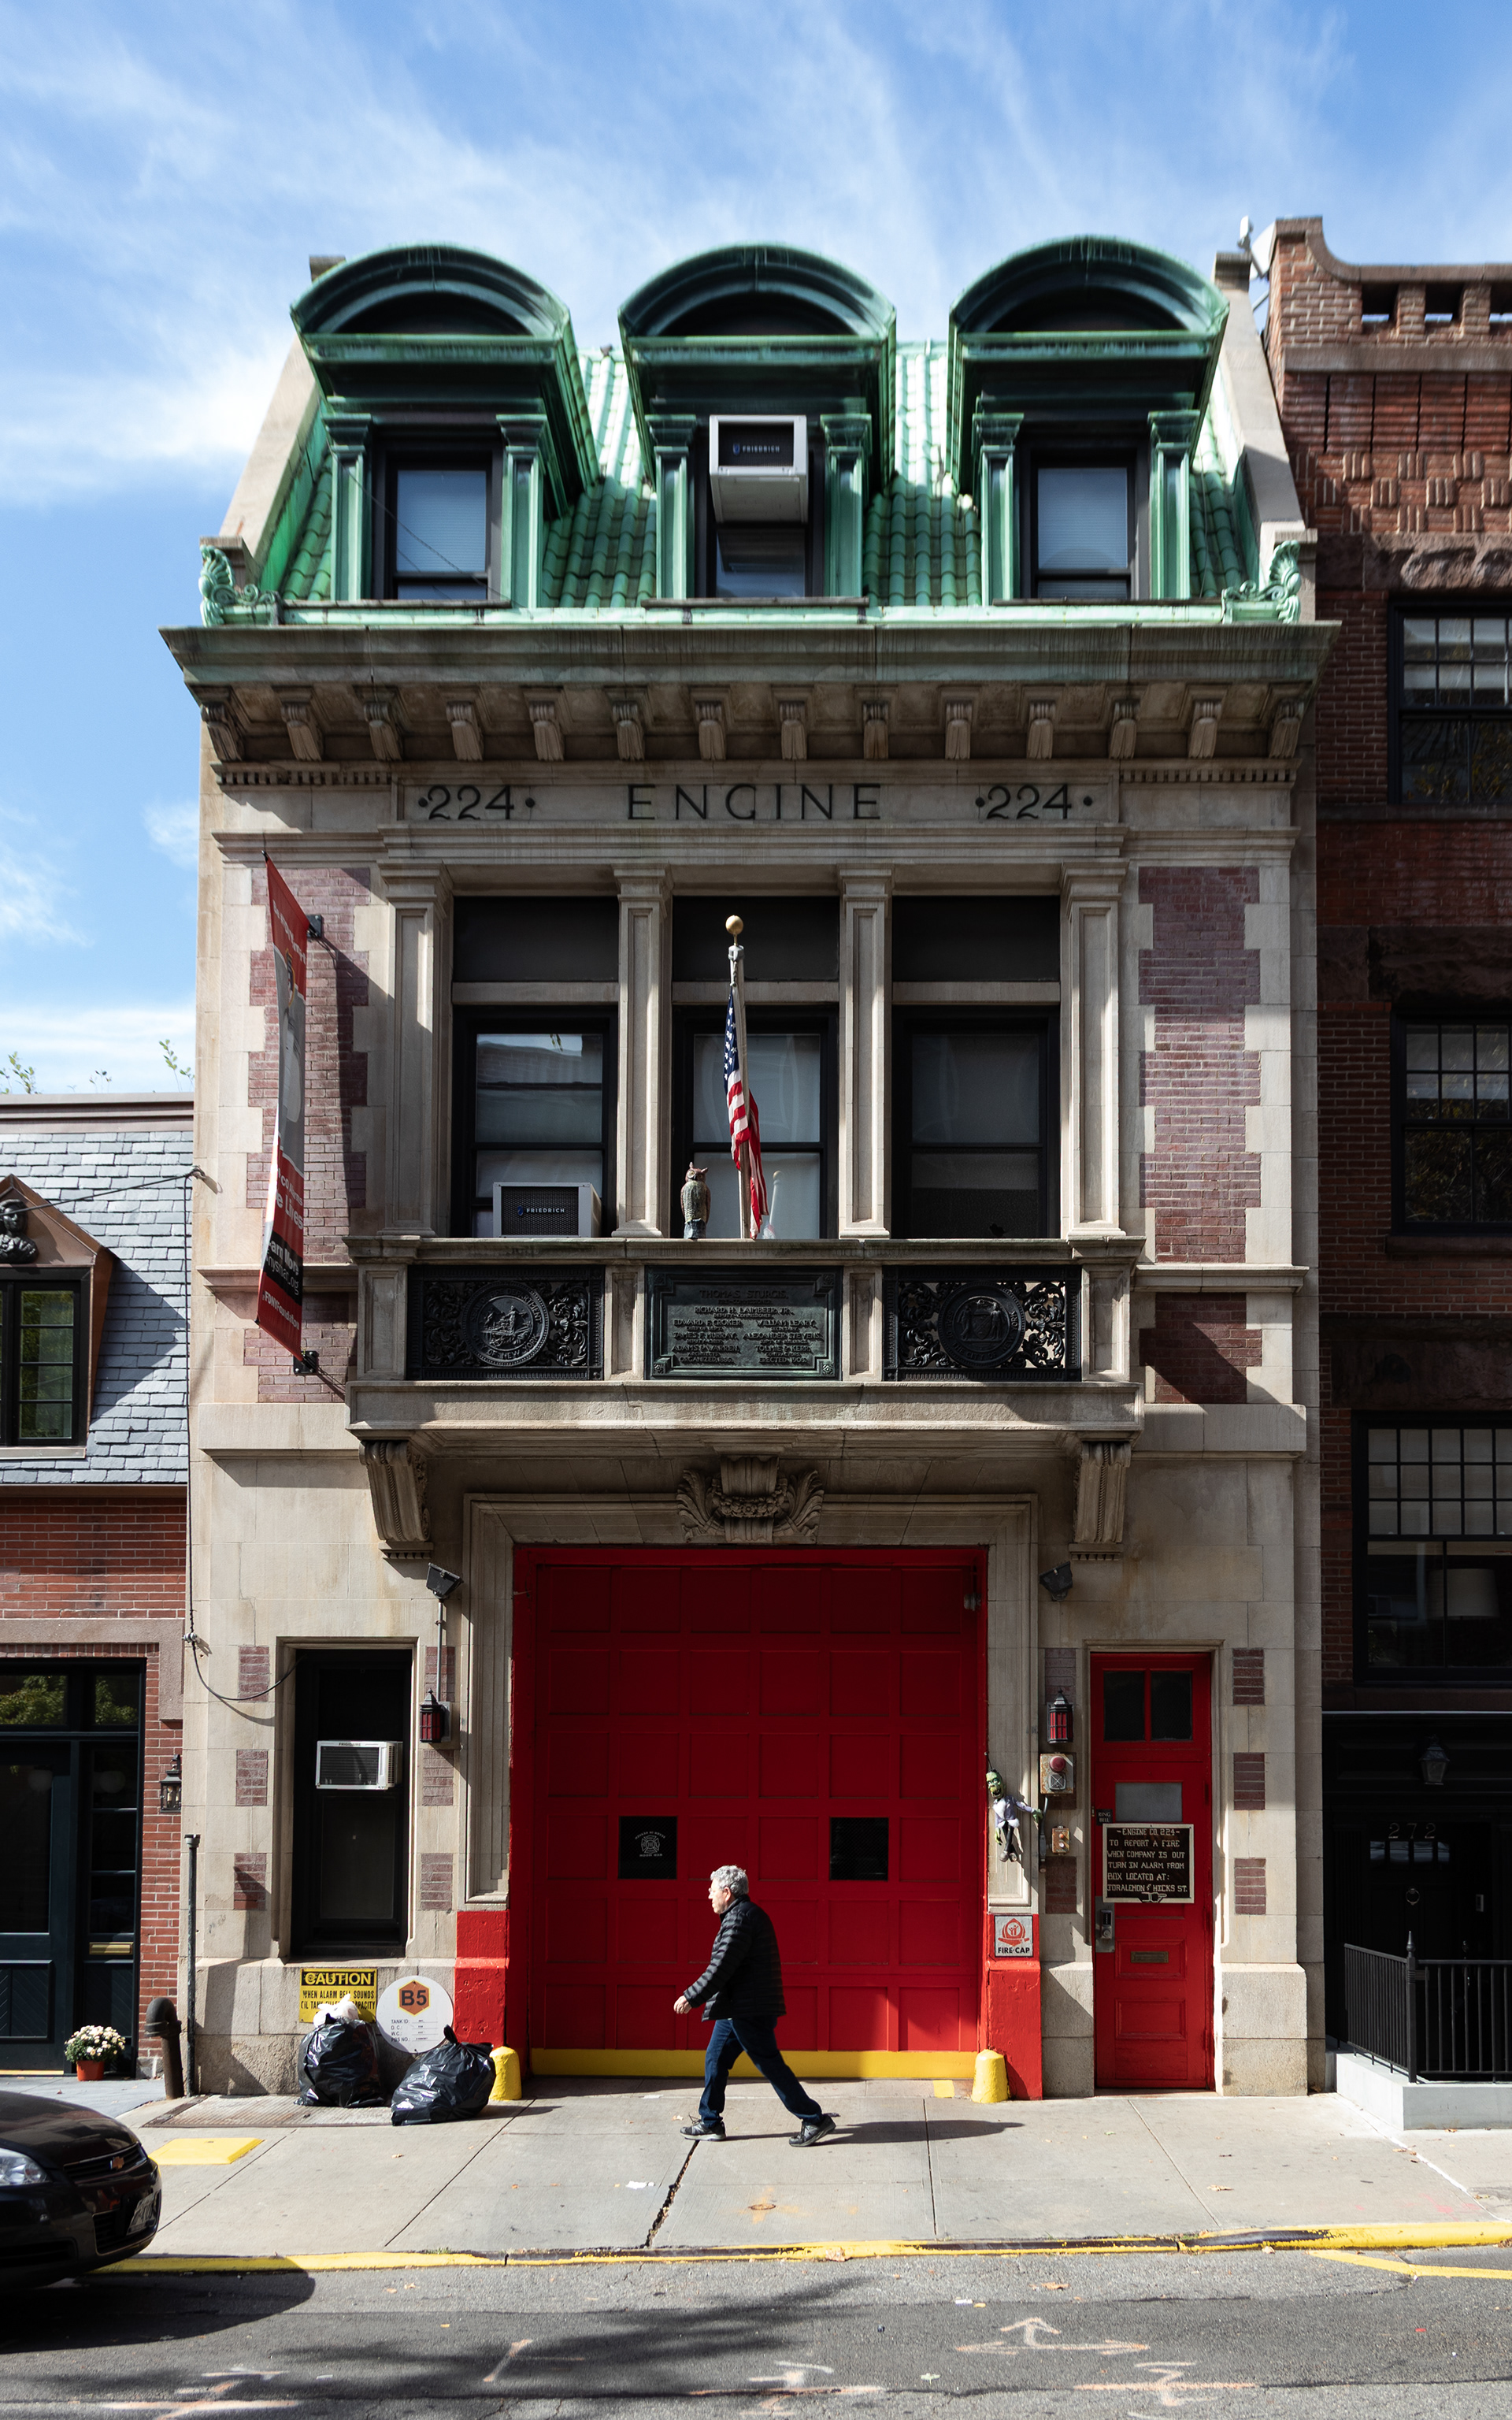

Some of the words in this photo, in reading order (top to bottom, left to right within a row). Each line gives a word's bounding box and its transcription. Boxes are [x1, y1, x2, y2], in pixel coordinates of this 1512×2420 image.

[427, 786, 514, 820] 224
[627, 784, 881, 820] ENGINE
[986, 784, 1072, 819] 224
[699, 1290, 740, 1299] THOMAS
[506, 1288, 543, 1323] DEPARTMENT
[522, 1333, 539, 1353] YORK
[1388, 1822, 1436, 1839] 272
[305, 1973, 371, 1985] CAUTION
[302, 1990, 318, 1999] WHEN
[320, 1990, 338, 1999] ALARM
[354, 1990, 375, 1999] SOUNDS
[401, 1989, 427, 2006] B5
